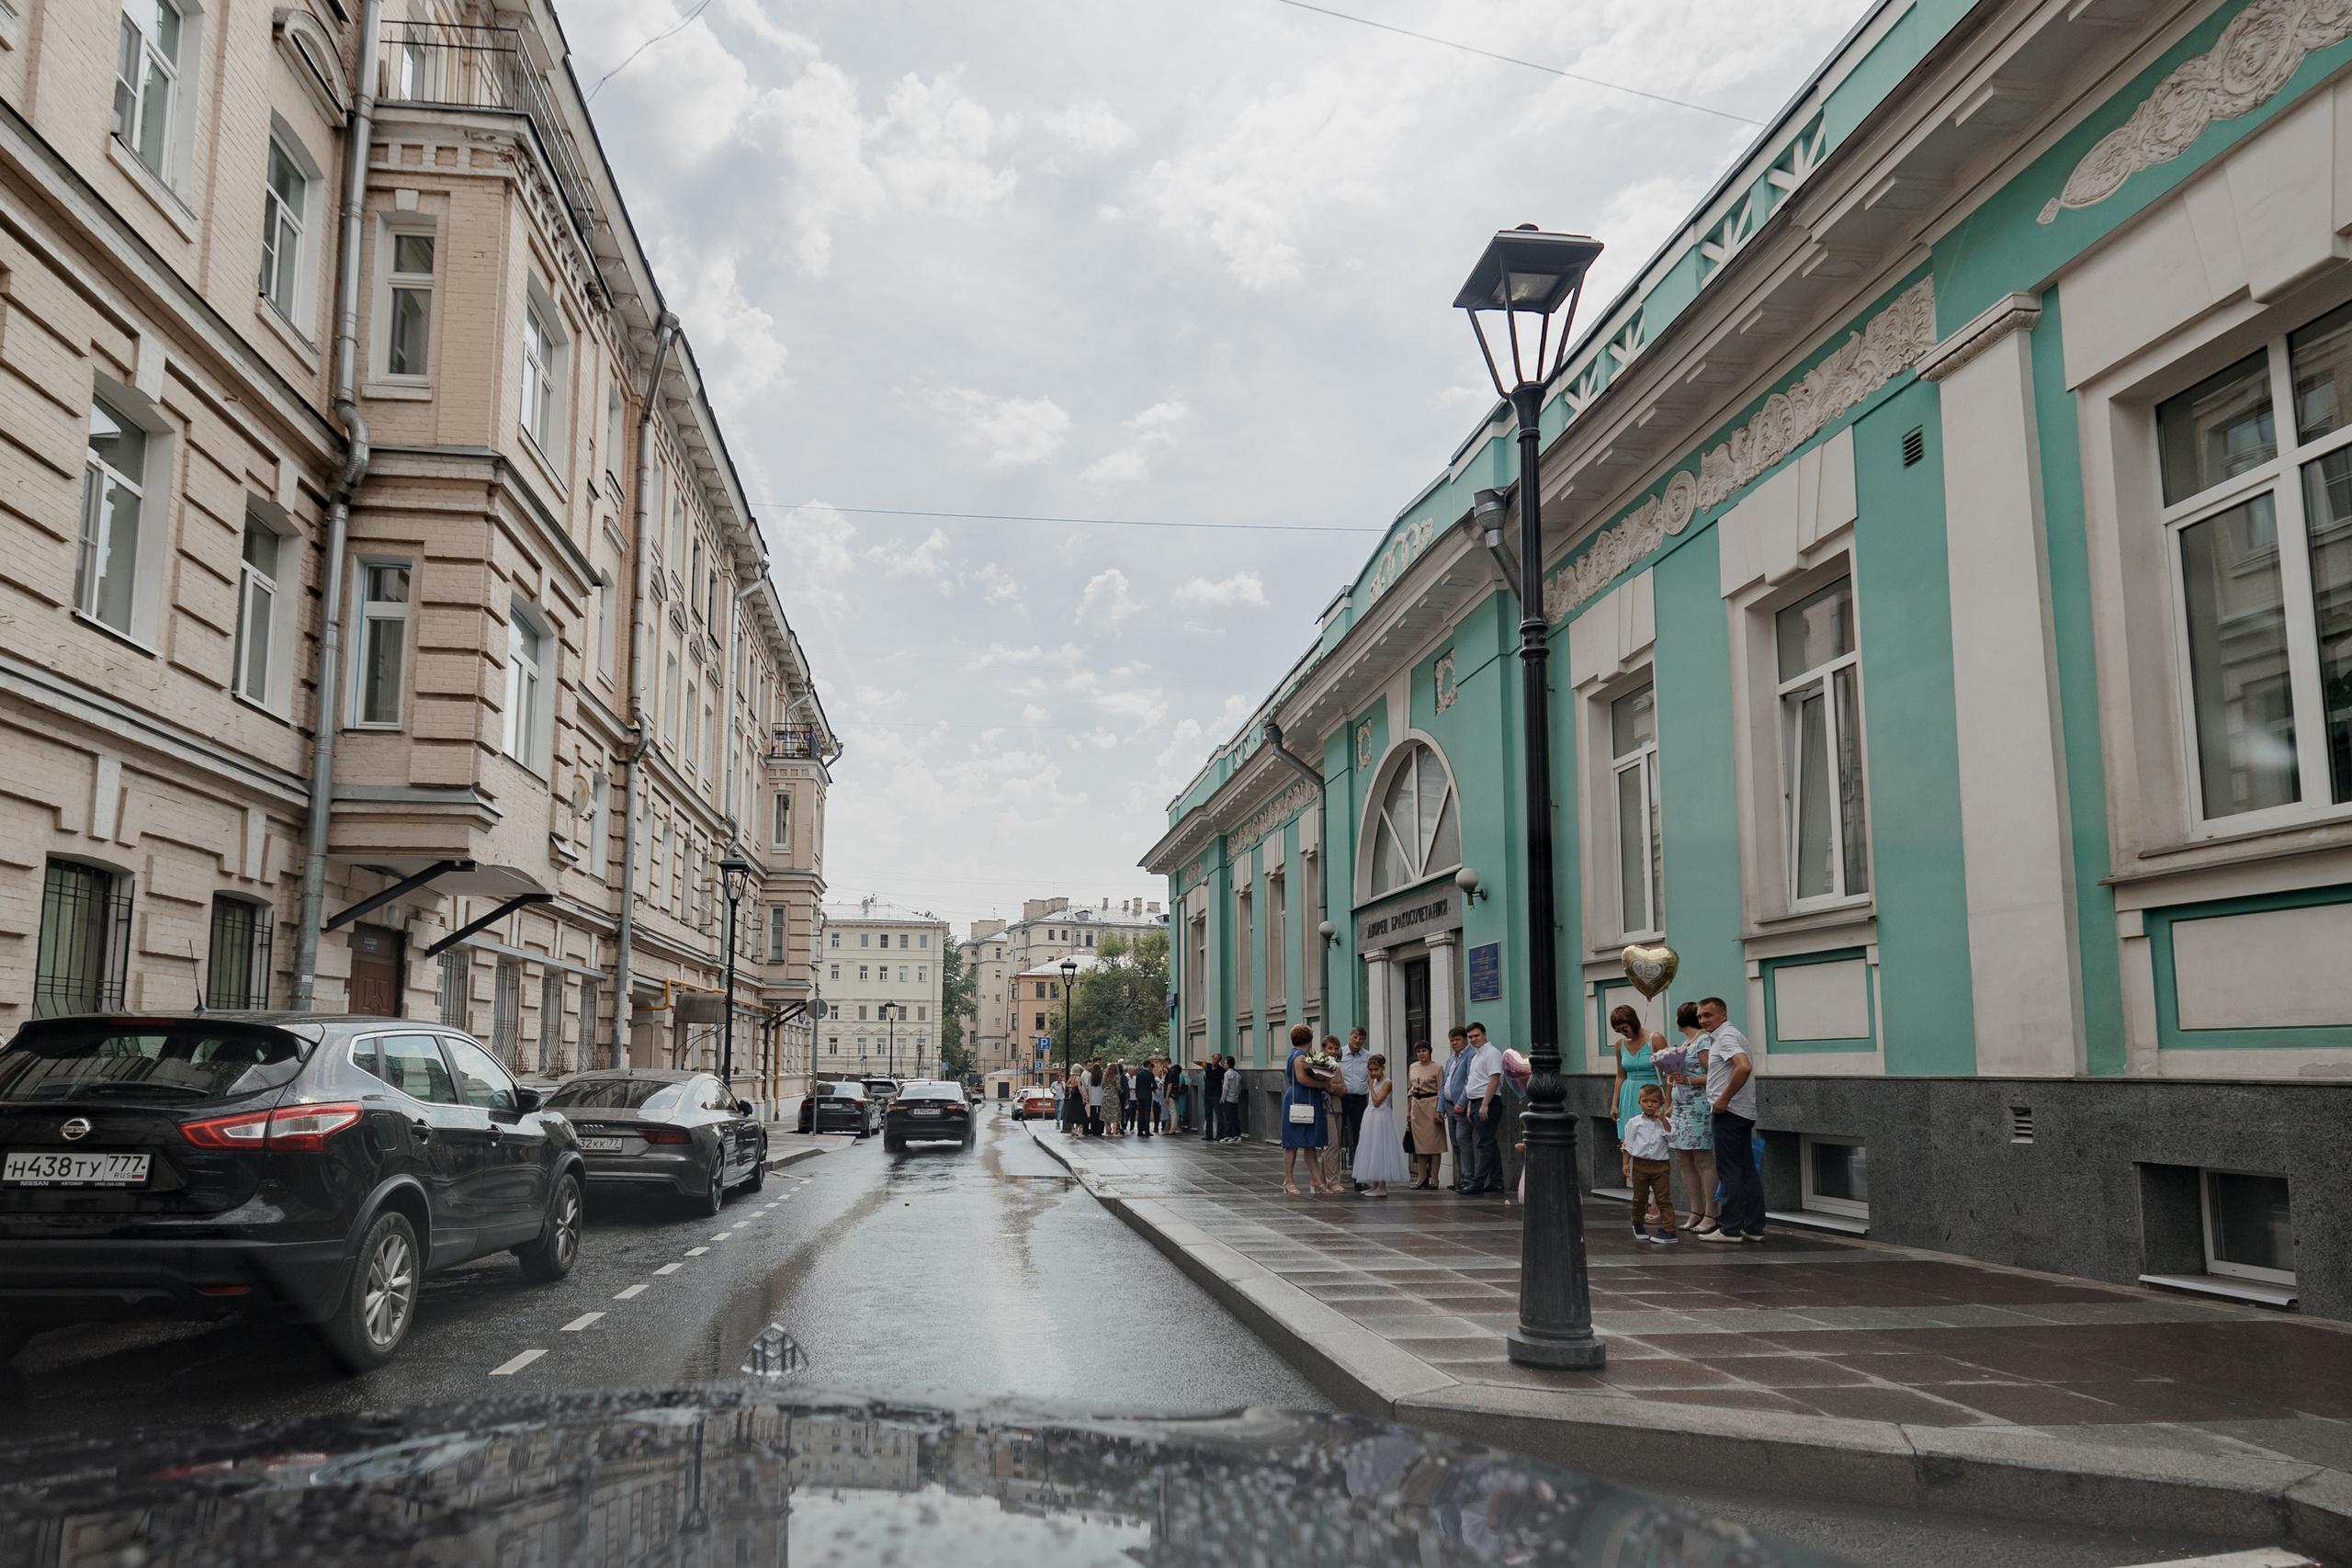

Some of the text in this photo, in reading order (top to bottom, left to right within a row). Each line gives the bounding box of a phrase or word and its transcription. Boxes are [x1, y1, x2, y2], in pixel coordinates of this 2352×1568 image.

[1391, 899, 1448, 931] БРАКОСОЧЕТАНИЯ
[580, 1139, 605, 1148] 32КК
[11, 1156, 144, 1178] Н438ТУ 777
